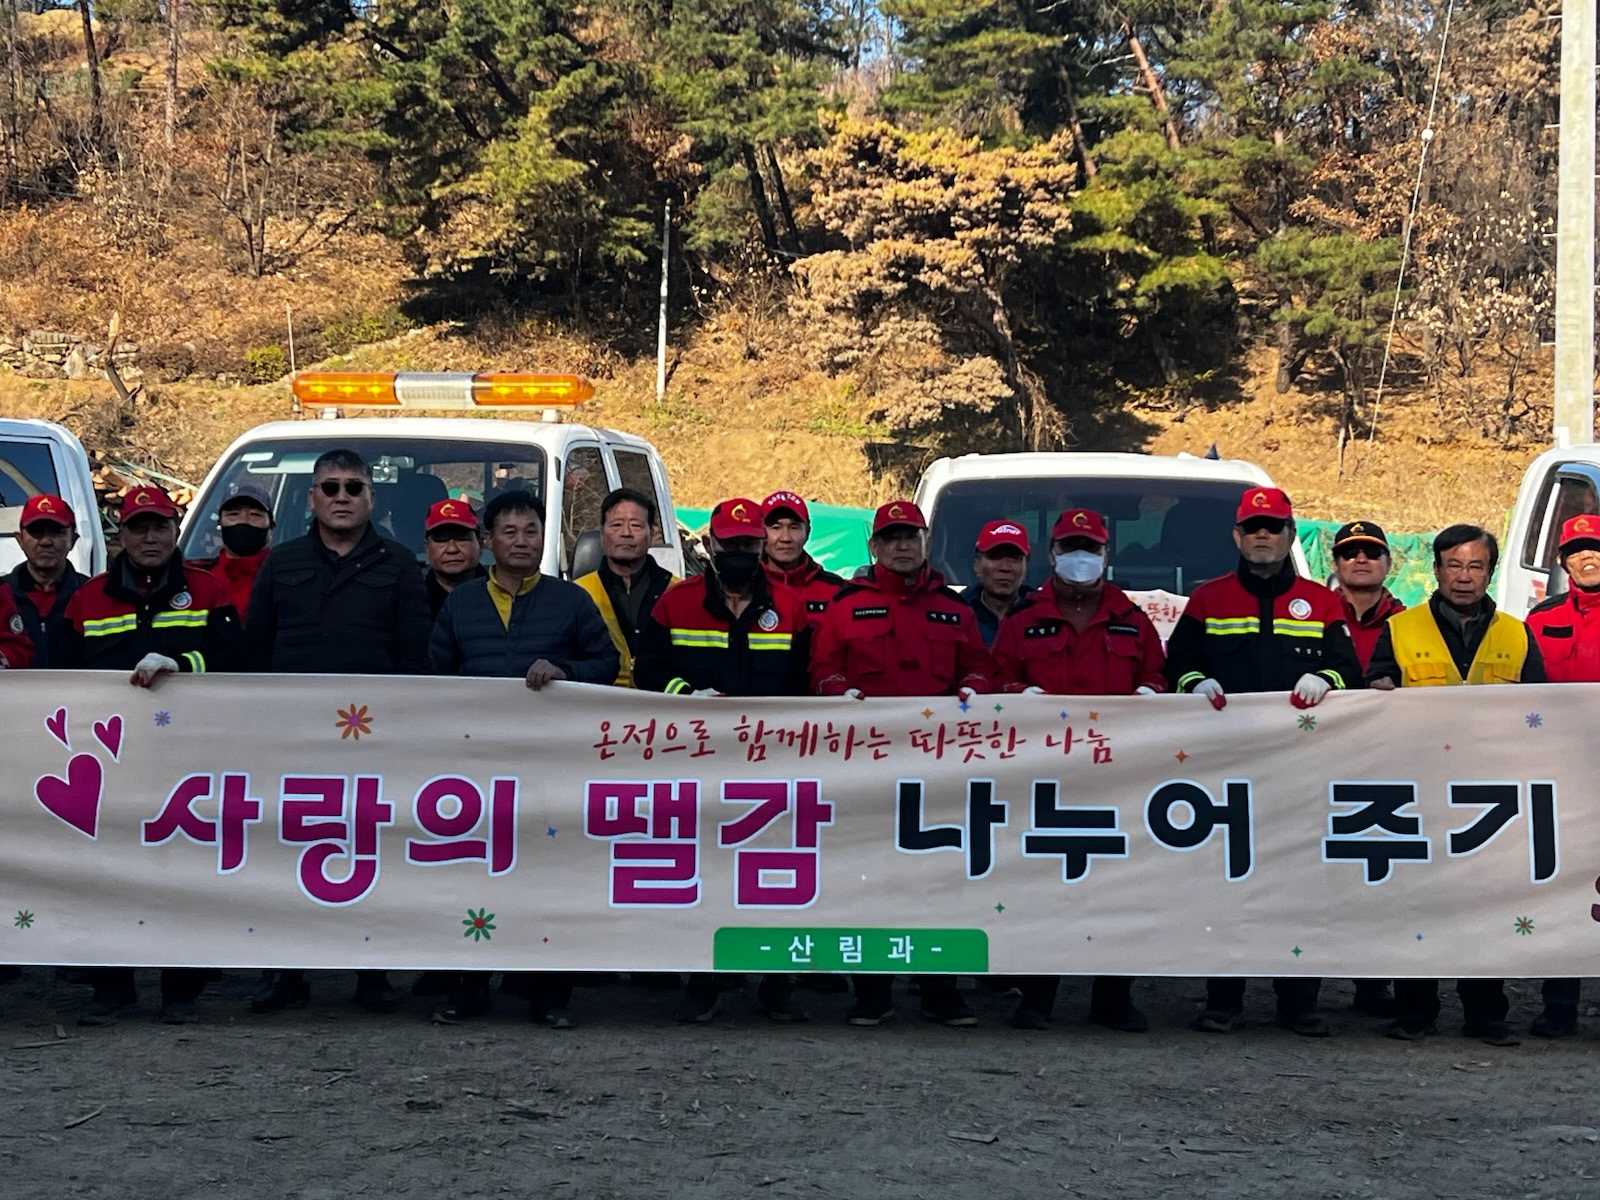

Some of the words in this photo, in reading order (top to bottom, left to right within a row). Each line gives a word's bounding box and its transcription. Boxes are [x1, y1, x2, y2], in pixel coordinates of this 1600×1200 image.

[1146, 602, 1182, 623] 뜻한
[592, 718, 716, 761] 온정으로
[732, 714, 892, 763] 함께하는
[908, 719, 1027, 764] 따뜻한
[1045, 725, 1113, 764] 나눔
[142, 774, 518, 905] 사랑의
[585, 778, 834, 908] 땔감
[896, 779, 1253, 882] 나누어
[1323, 781, 1558, 884] 주기
